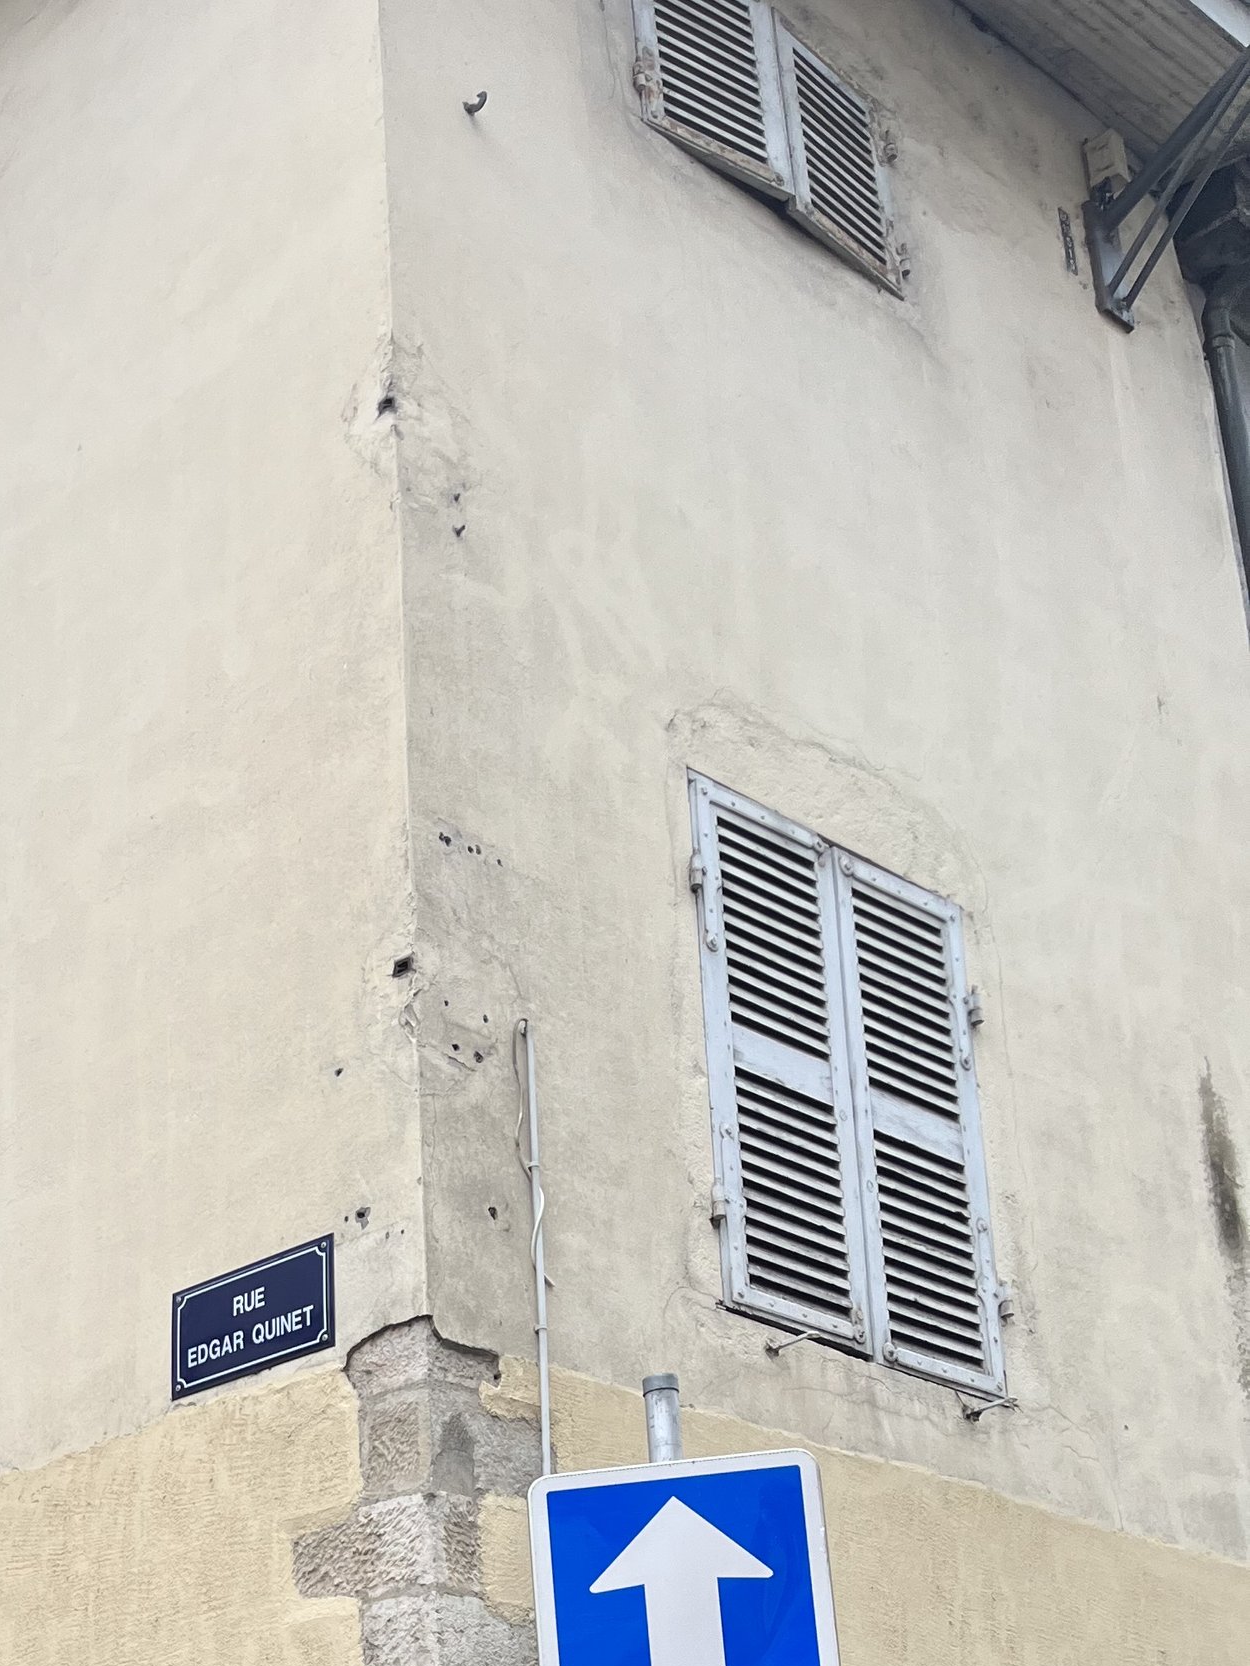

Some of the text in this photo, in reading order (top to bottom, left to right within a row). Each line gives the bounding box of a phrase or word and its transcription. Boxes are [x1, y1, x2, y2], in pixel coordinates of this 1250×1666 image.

[233, 1287, 265, 1317] RUE
[187, 1305, 314, 1368] EDGAR QUINET
